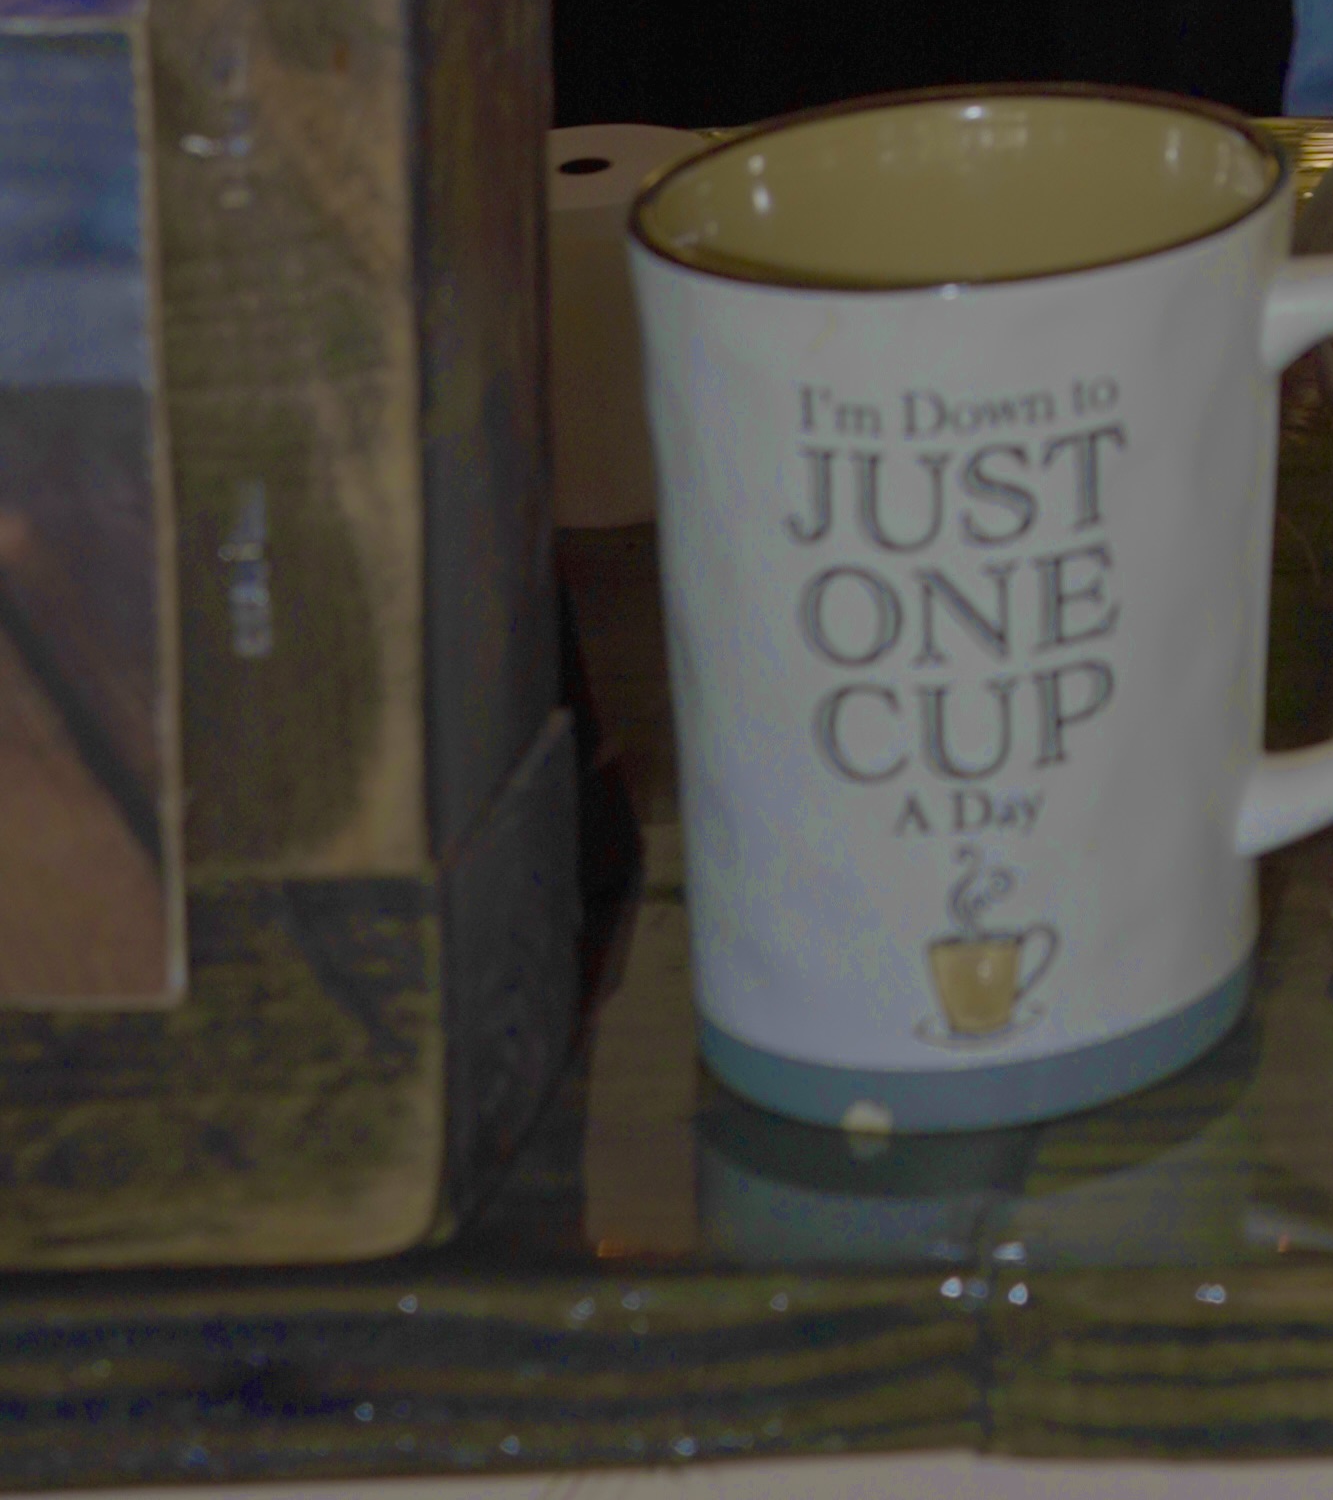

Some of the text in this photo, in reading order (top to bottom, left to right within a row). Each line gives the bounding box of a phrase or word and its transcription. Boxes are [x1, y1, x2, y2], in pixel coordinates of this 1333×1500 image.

[797, 374, 1119, 438] I'm Down to
[784, 420, 1127, 552] JUST
[801, 542, 1121, 668] ONE
[814, 656, 1116, 785] CUP
[894, 789, 1044, 838] A Day
